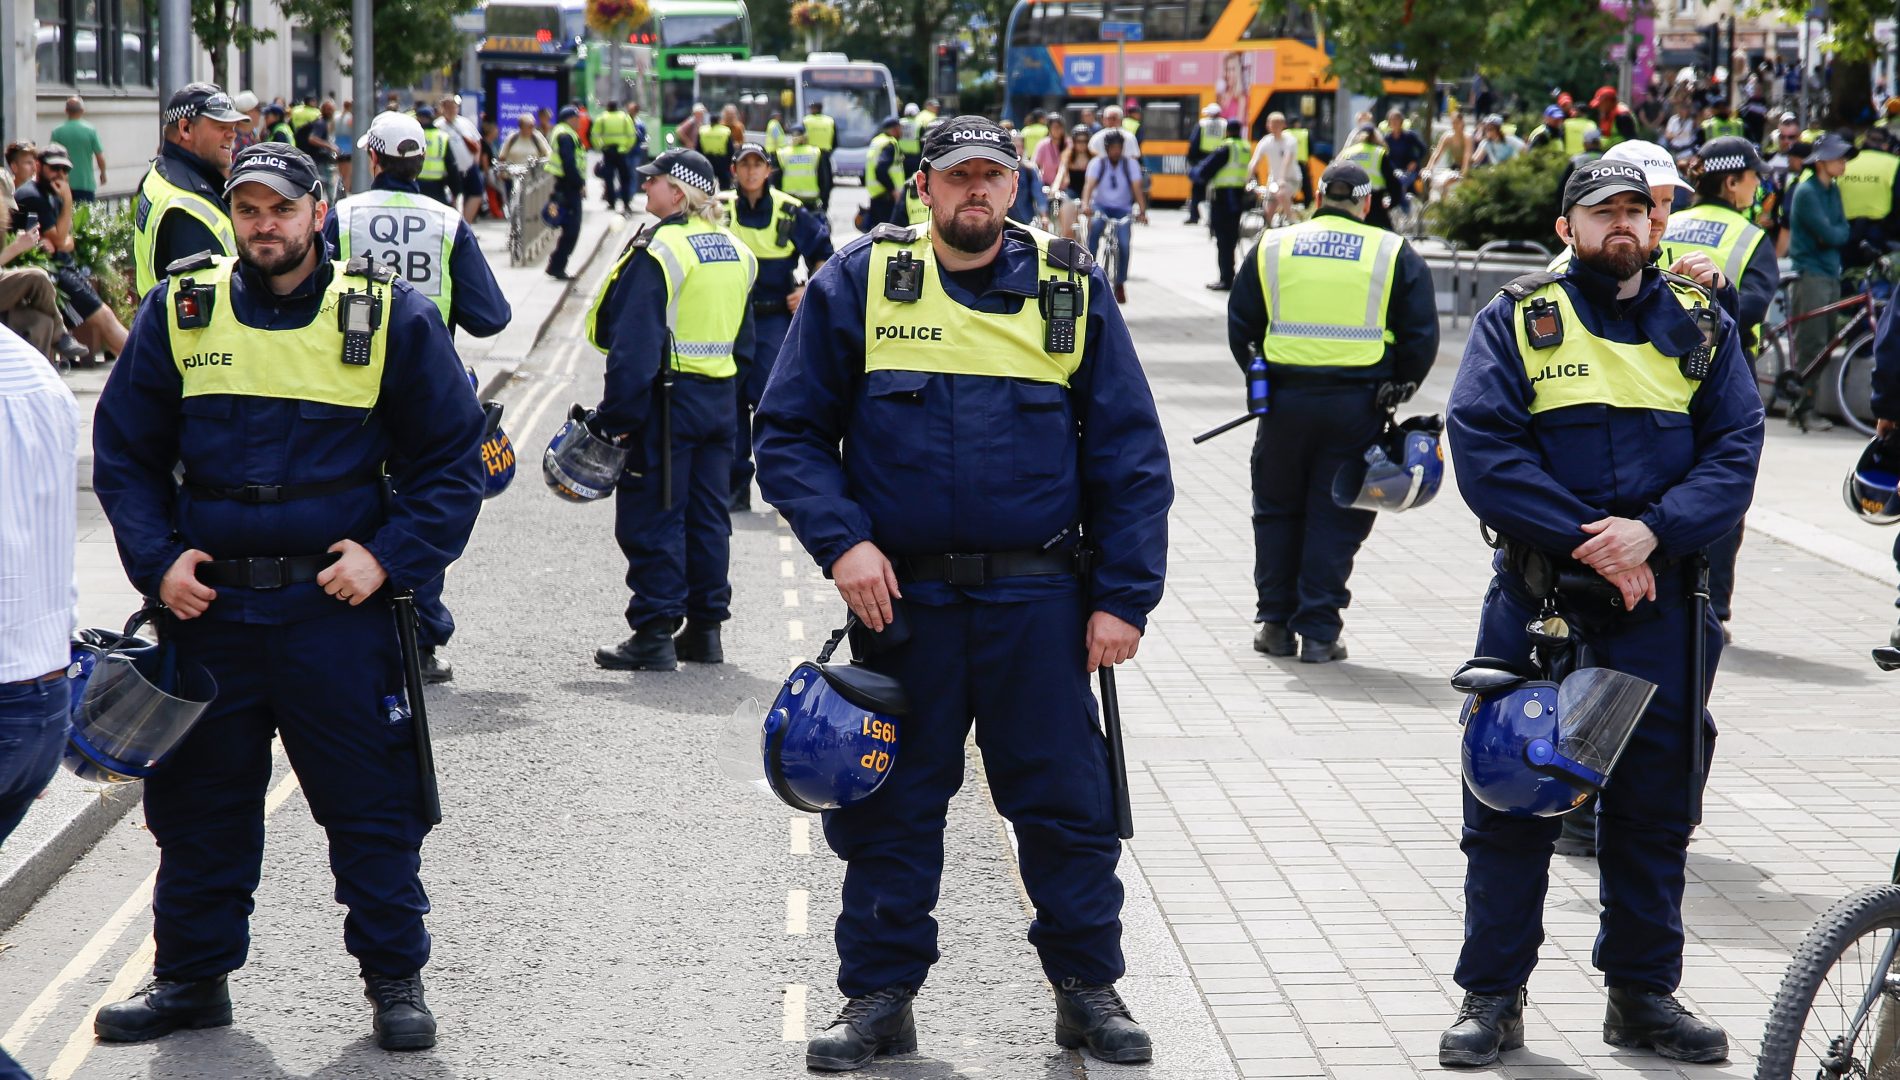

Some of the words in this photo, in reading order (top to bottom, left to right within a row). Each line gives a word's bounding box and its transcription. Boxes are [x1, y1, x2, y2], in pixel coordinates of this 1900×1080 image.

[952, 129, 1001, 142] POLICE
[241, 155, 287, 170] POLICE
[1644, 159, 1675, 169] POLICE
[1591, 166, 1643, 182] POLICE
[369, 214, 427, 246] QP
[699, 246, 738, 261] POLICE
[1298, 243, 1356, 258] POLICE
[876, 325, 942, 341] POLICE
[1530, 363, 1589, 384] LICE
[486, 449, 514, 476] WH
[574, 485, 599, 499] POLICE
[863, 716, 897, 744] 1951
[860, 749, 889, 773] QP
